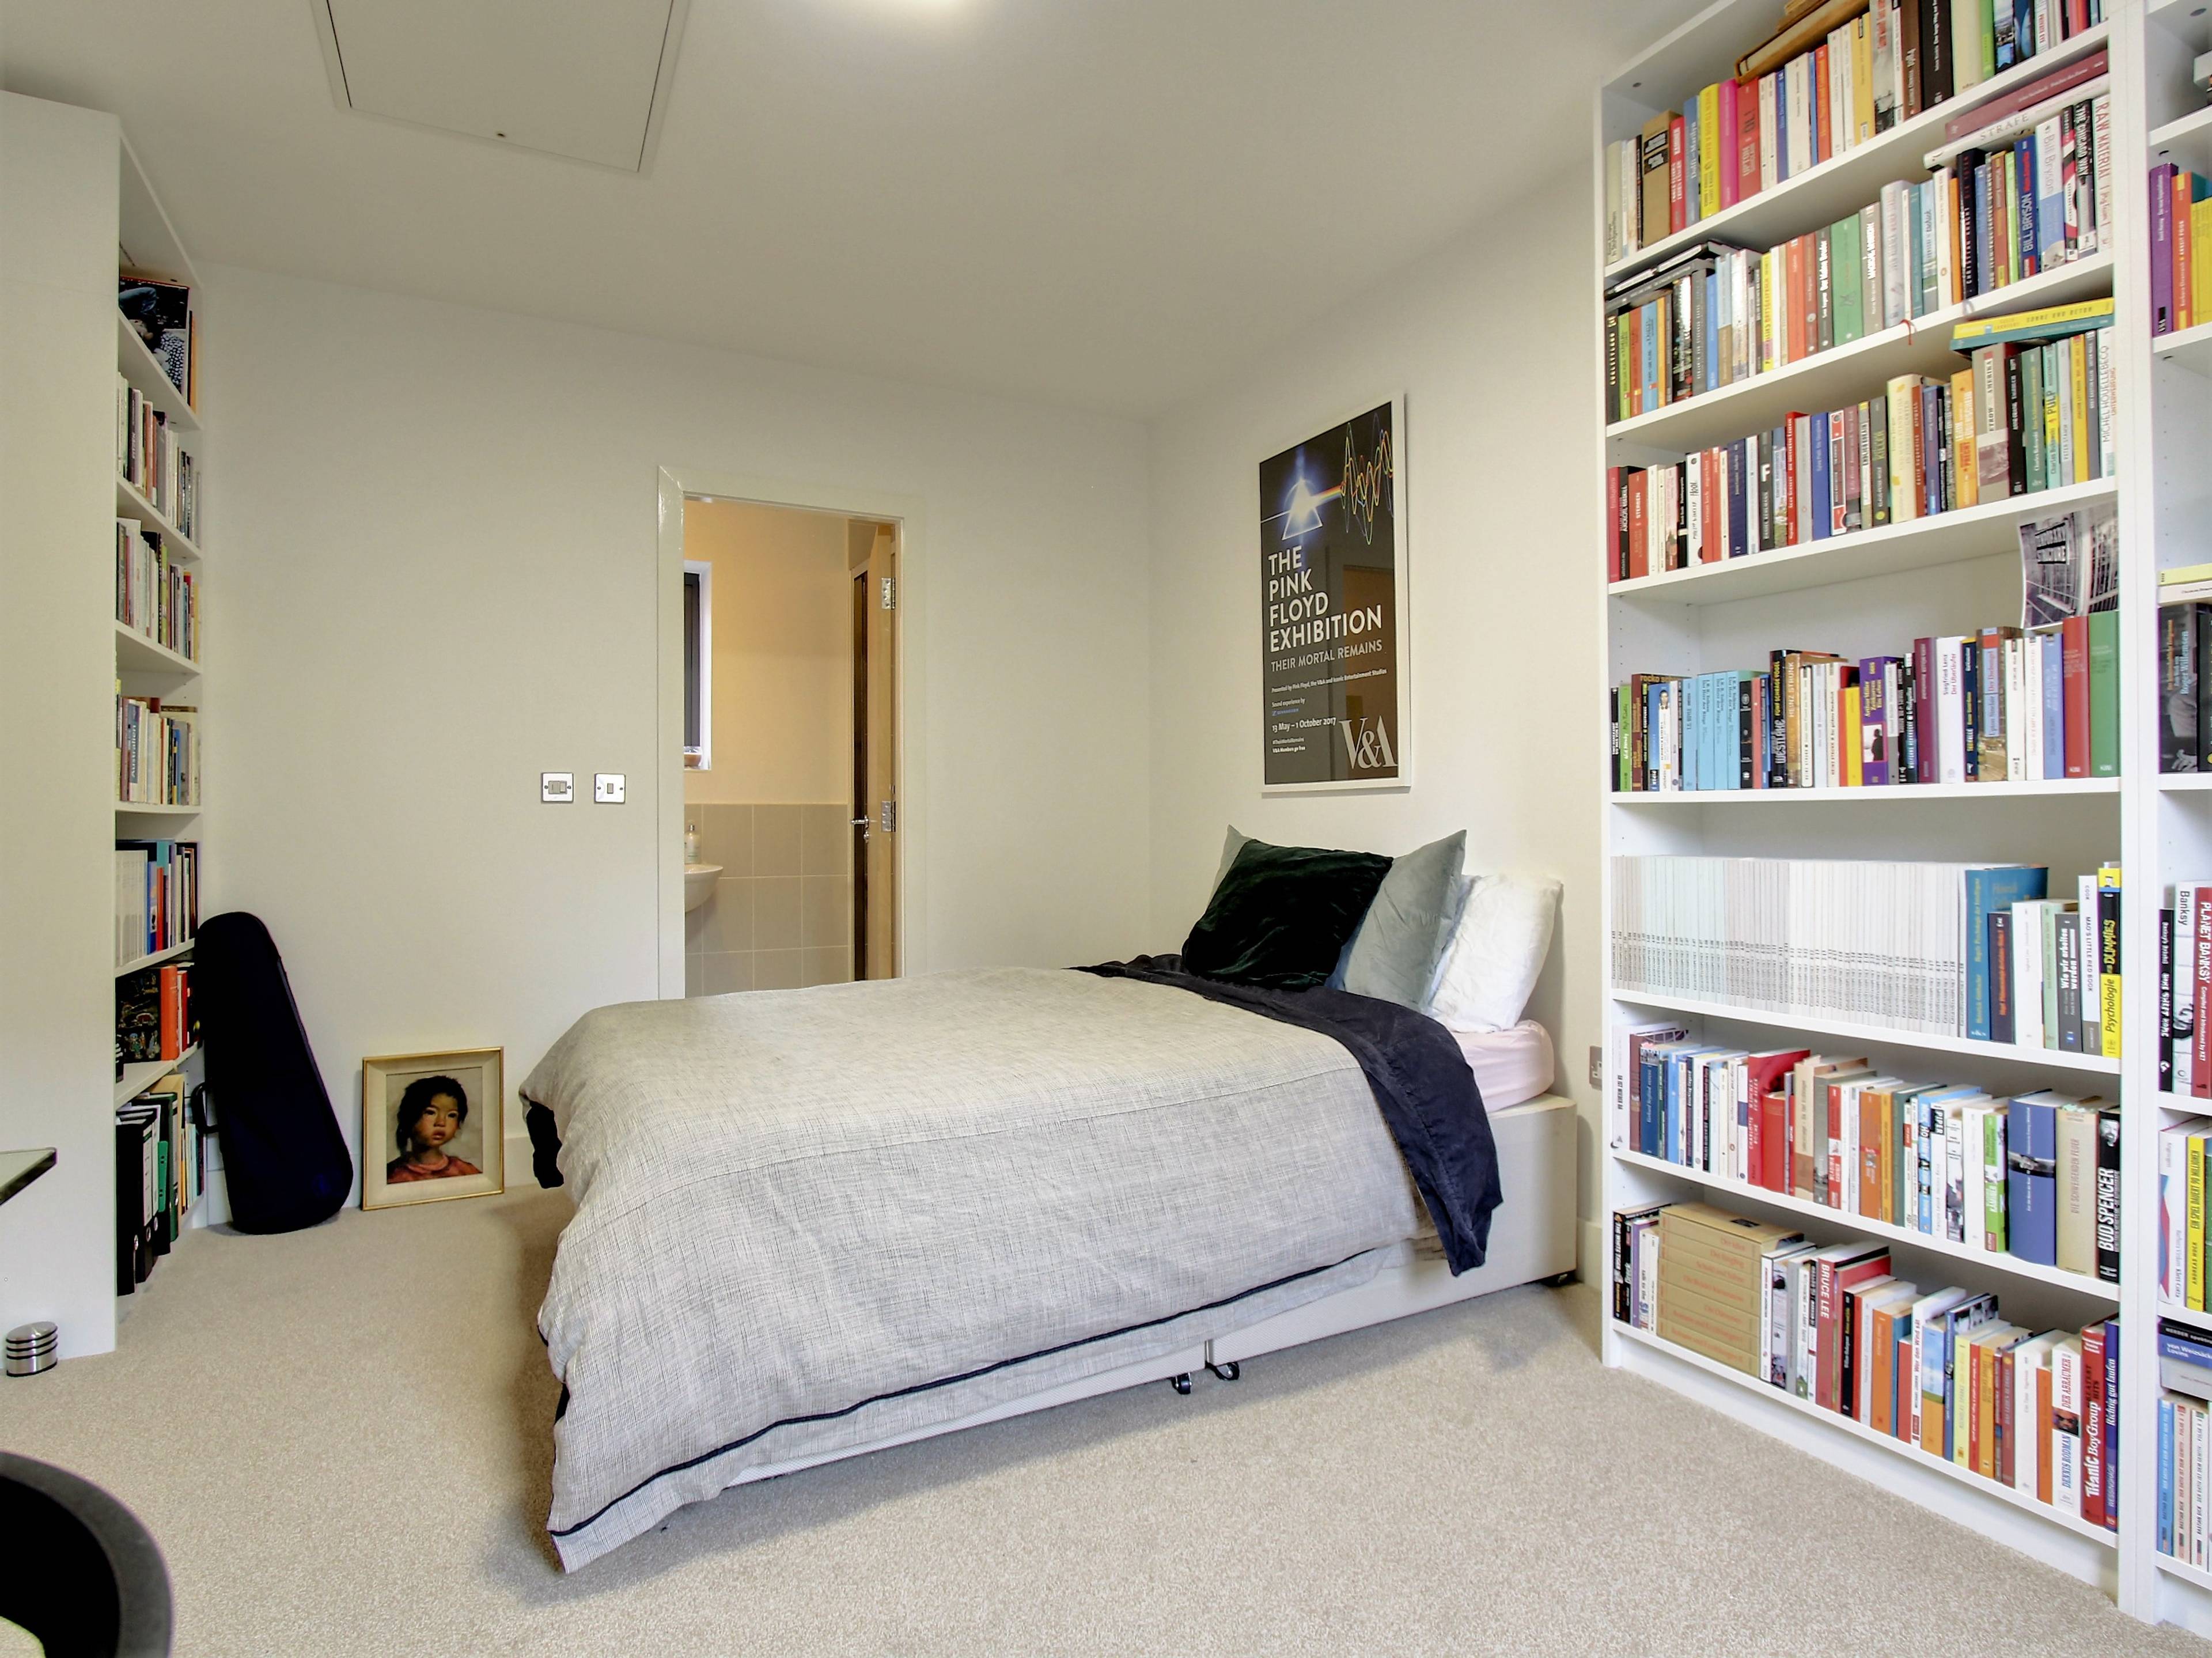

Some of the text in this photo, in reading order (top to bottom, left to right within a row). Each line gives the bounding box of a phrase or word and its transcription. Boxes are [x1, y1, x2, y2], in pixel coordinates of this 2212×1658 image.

[2043, 134, 2056, 194] Bill Bryson
[2075, 107, 2089, 176] THE CHICAGO WAY
[2096, 103, 2110, 180] RAW MATERIAL
[2021, 192, 2034, 252] BILL BRYSON
[2046, 390, 2057, 415] PULP
[2100, 345, 2111, 442] MICHEL HOUELLEBECQ
[1987, 407, 1995, 433] ETROW
[1268, 545, 1303, 576] THE
[1268, 568, 1313, 602] PINK
[1269, 591, 1329, 627] FLOYD
[1270, 604, 1382, 653] EXHIBITION
[1271, 640, 1383, 673] THEIR MORTAL REMAINS
[2179, 630, 2190, 695] Roger Willemsen
[1272, 724, 1278, 734] 13
[1278, 722, 1291, 732] May
[1299, 717, 1323, 729] October
[1323, 717, 1337, 726] 2017
[1338, 714, 1399, 770] V&A
[1774, 719, 1786, 764] WESTLAKE
[2177, 891, 2191, 926] Banksy
[2103, 919, 2116, 964] DUMMIES
[2197, 902, 2212, 983] PLANET BANKSY
[2104, 979, 2116, 1033] Psychologie
[1934, 1109, 1944, 1134] PIPER
[2070, 1138, 2080, 1156] FEUER
[2070, 1157, 2080, 1203] SCHWEIGENDEN
[2190, 1150, 2200, 1230] EIN SPIEL DAUERT 90 MILLIONEN
[2097, 1167, 2115, 1252] BUD SPENCER
[1820, 1263, 1831, 1319] BRUCE LEE
[2100, 1266, 2117, 1278] H
[1912, 1330, 1921, 1346] Wind
[1912, 1347, 1921, 1359] den
[1912, 1360, 1921, 1373] Wer
[2061, 1358, 2072, 1409] DER ABRÄUMER
[2105, 1359, 2116, 1426] Richtig gut laufen
[2085, 1401, 2101, 1456] BoyGroup
[2062, 1434, 2072, 1489] DENNIS RODMAN
